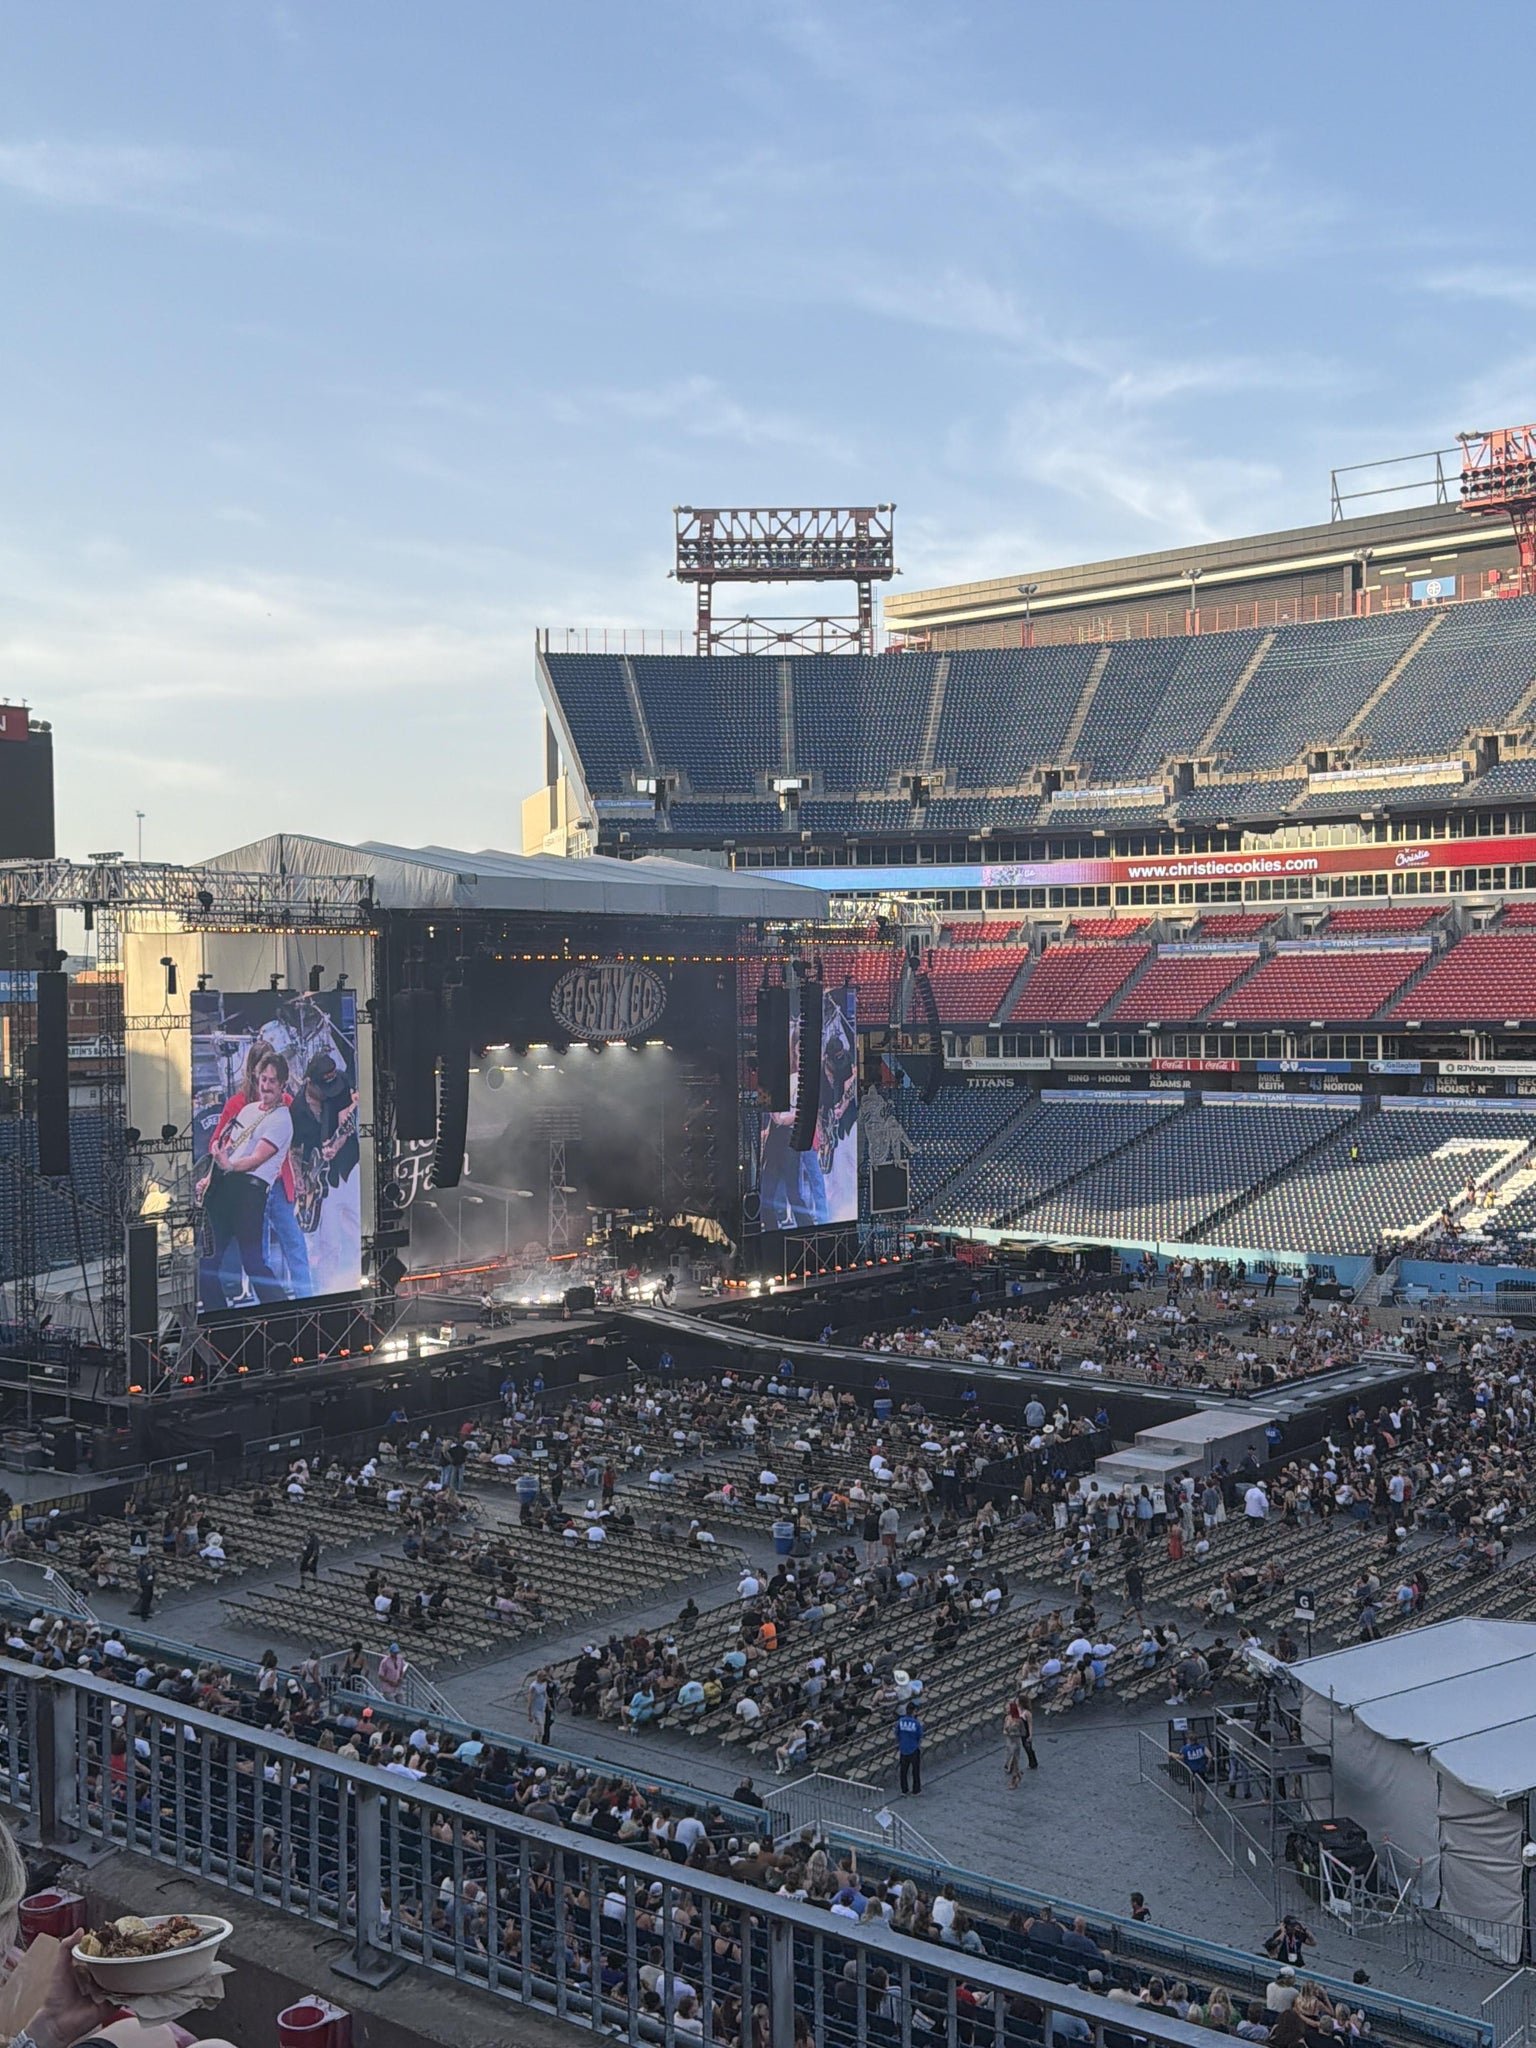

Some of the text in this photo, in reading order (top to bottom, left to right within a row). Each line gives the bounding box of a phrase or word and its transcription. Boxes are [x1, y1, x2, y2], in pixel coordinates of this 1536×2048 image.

[1128, 857, 1318, 878] www.christiecookies.com
[966, 1078, 1015, 1088] TITANS
[1067, 1075, 1090, 1083] RING
[1098, 1075, 1131, 1083] HONOR
[1324, 1075, 1339, 1083] JIM
[1150, 1080, 1191, 1088] ADAMS JR
[1258, 1082, 1285, 1090] KEITH
[1323, 1083, 1363, 1091] NORTON
[1436, 1085, 1486, 1094] HOUSTN
[536, 1440, 544, 1449] B
[798, 1483, 806, 1493] C
[134, 1534, 143, 1545] A
[1299, 1595, 1310, 1608] G
